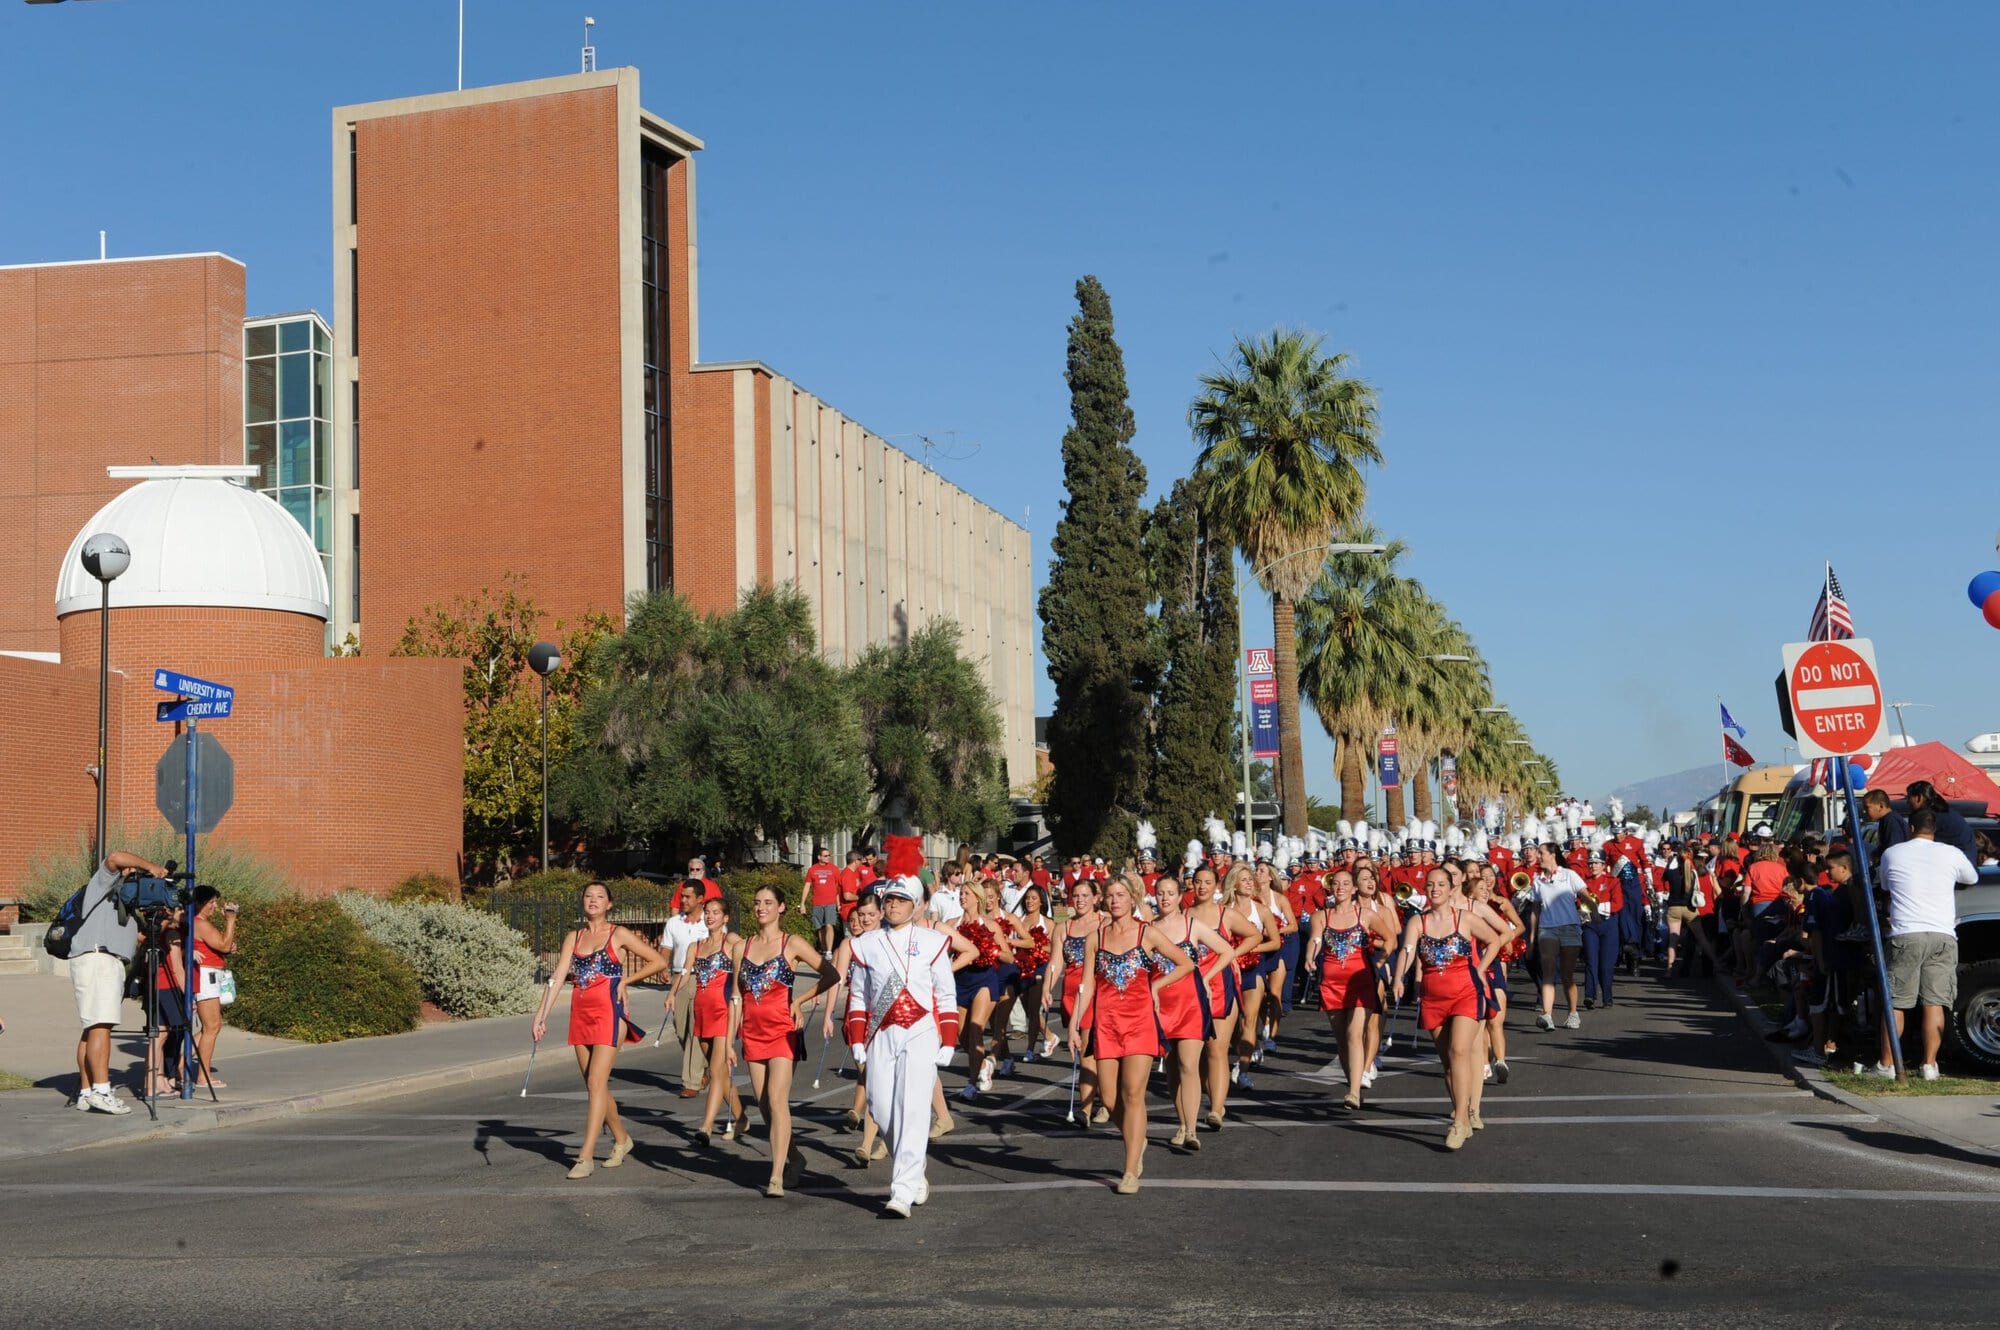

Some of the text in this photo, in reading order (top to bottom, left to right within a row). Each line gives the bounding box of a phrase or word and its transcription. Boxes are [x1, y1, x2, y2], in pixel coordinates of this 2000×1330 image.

[1249, 650, 1273, 674] A
[1800, 662, 1861, 683] DO NOT
[179, 678, 215, 699] UNIVERSITY
[186, 701, 229, 716] CHERRY AVE
[1815, 712, 1866, 733] ENTER
